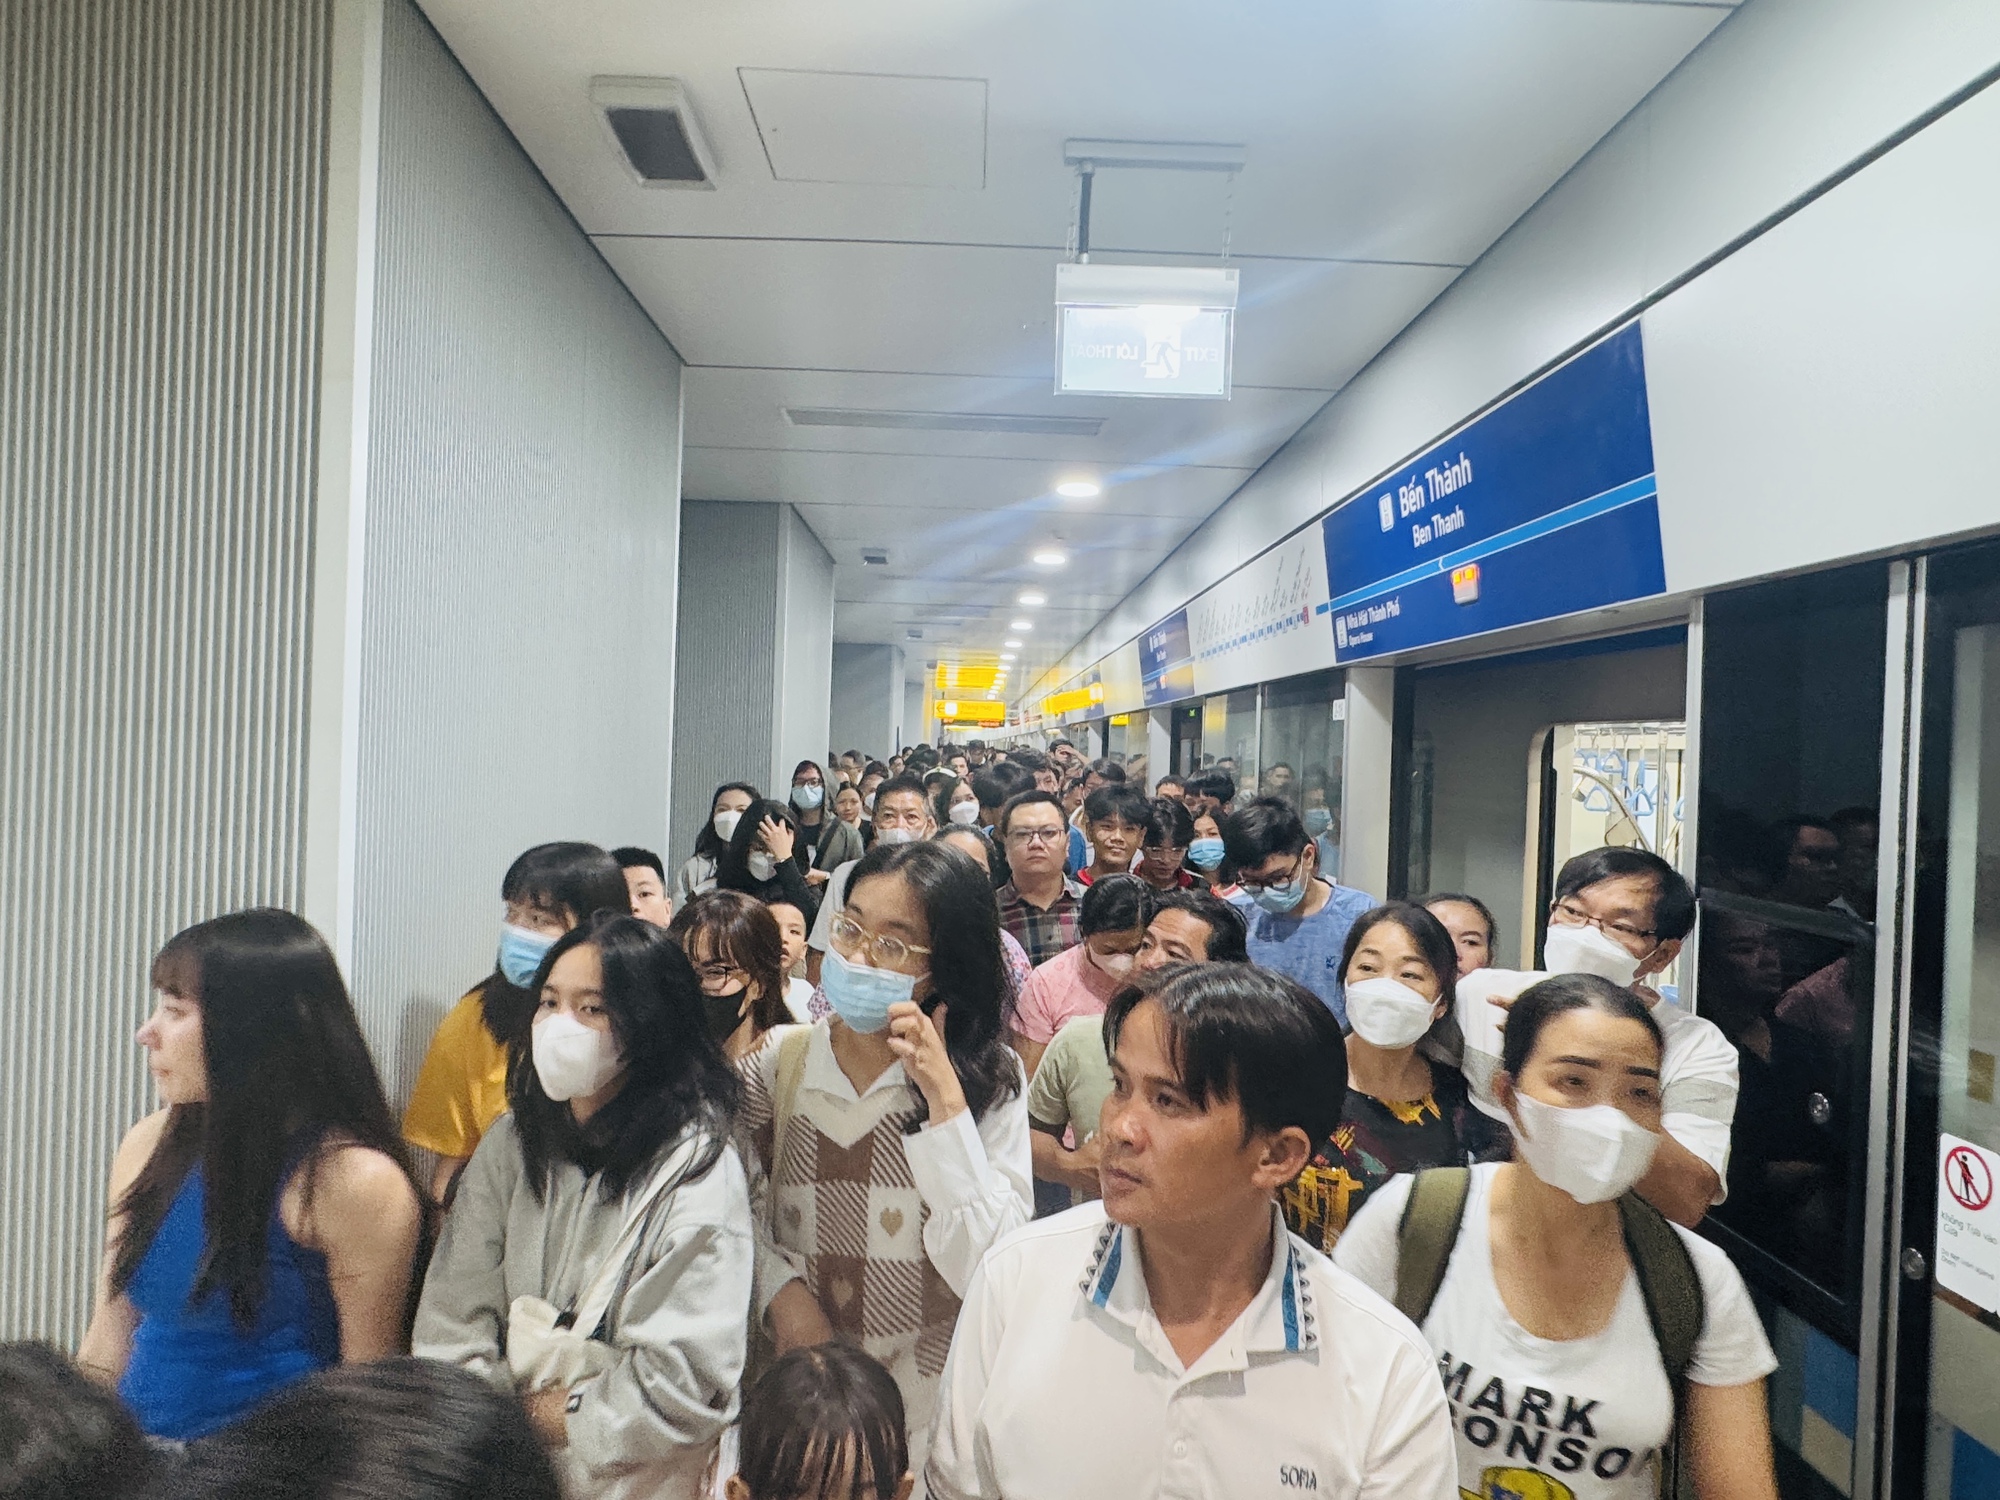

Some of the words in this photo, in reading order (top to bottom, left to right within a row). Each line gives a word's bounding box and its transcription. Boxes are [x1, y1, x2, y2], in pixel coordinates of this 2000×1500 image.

[1398, 474, 1426, 519] Bến
[1424, 451, 1473, 503] Thành
[1412, 523, 1432, 548] Ben
[1431, 504, 1465, 538] Thanh
[1449, 1400, 1634, 1480] ONSO
